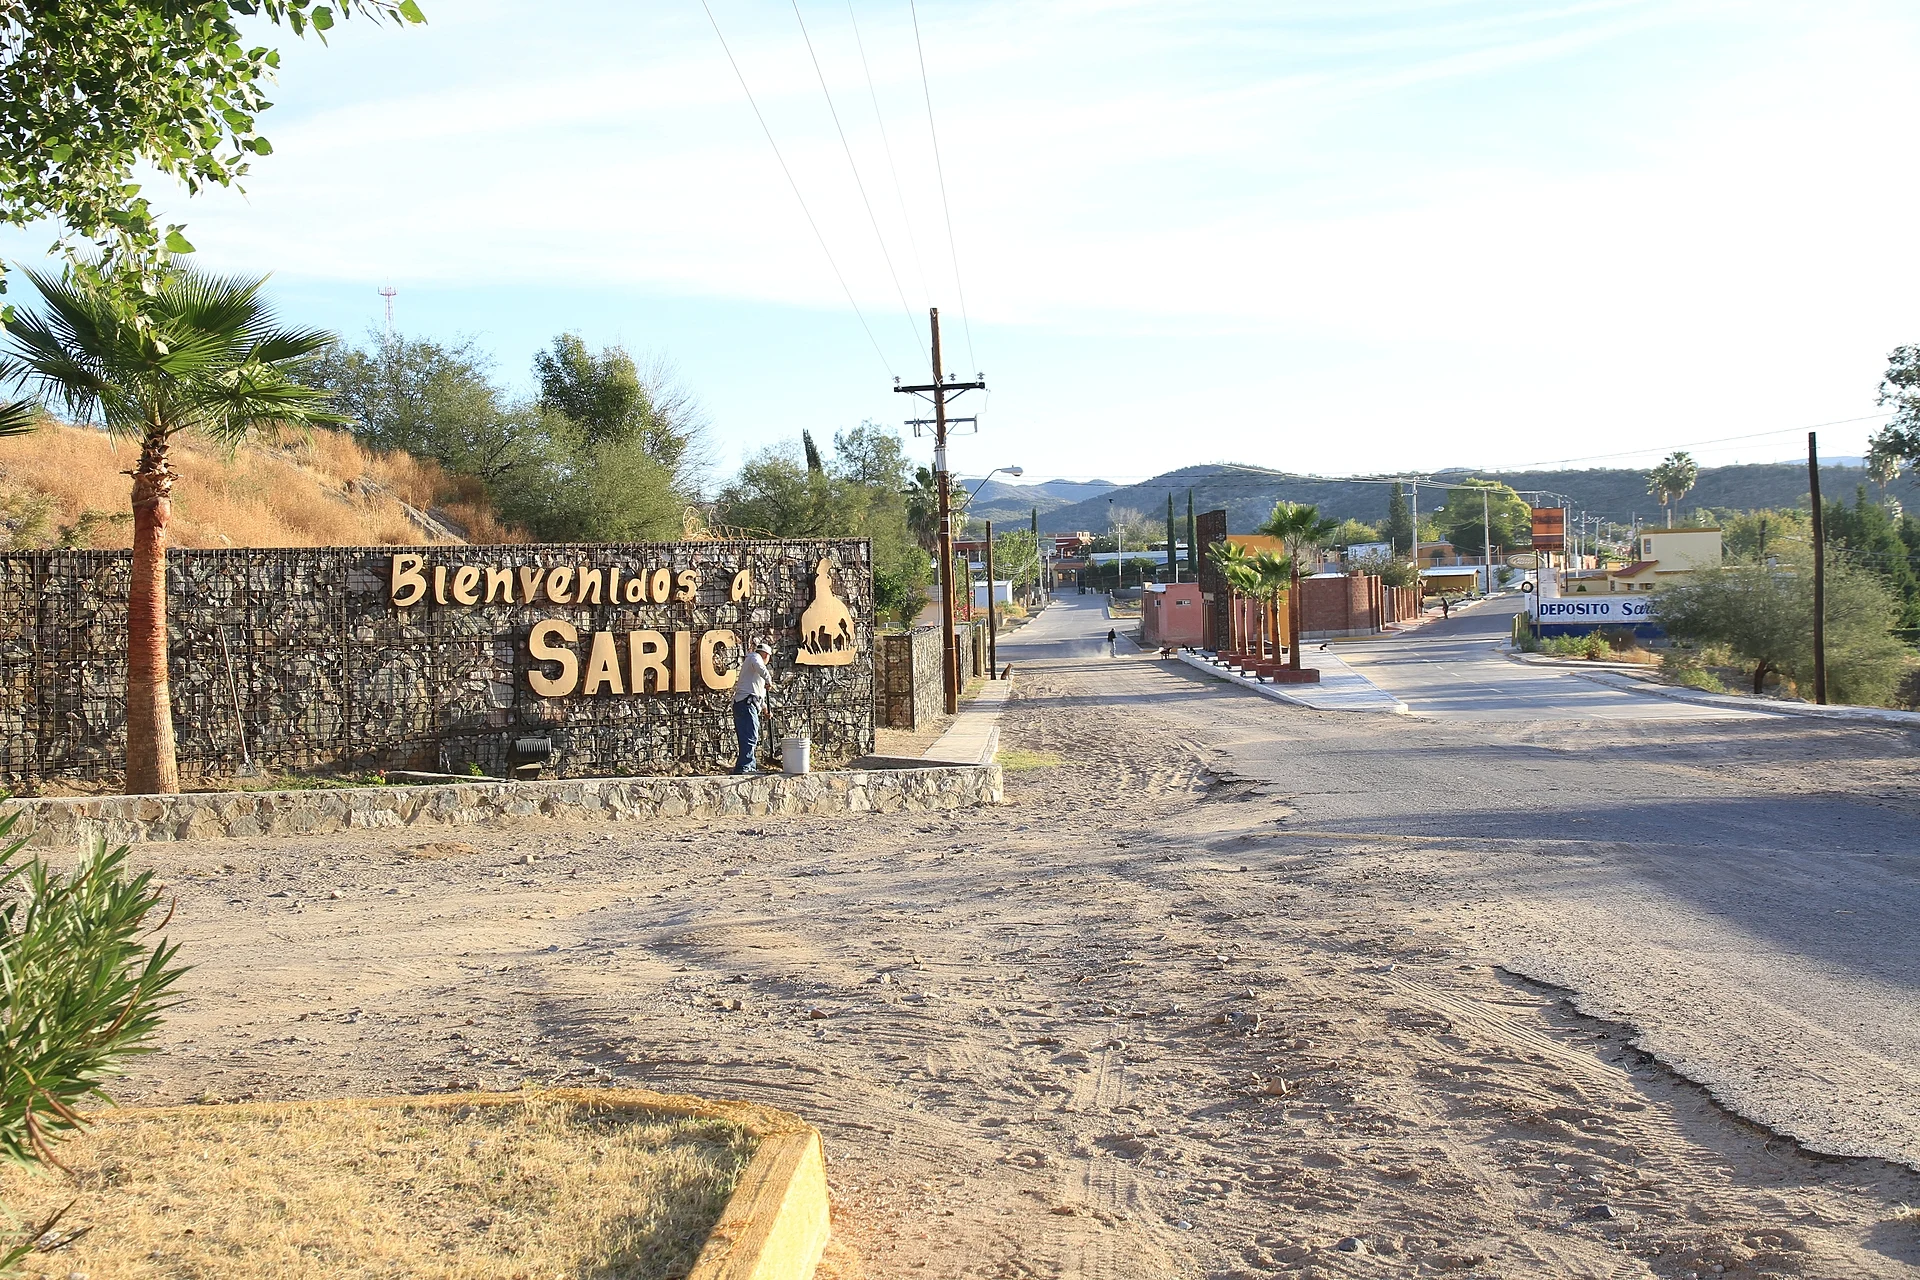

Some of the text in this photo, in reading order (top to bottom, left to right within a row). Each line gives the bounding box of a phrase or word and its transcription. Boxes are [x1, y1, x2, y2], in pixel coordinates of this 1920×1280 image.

[391, 553, 751, 607] Bienvenidos a
[1540, 603, 1610, 616] DEPOSITO
[527, 619, 738, 697] SARIC
